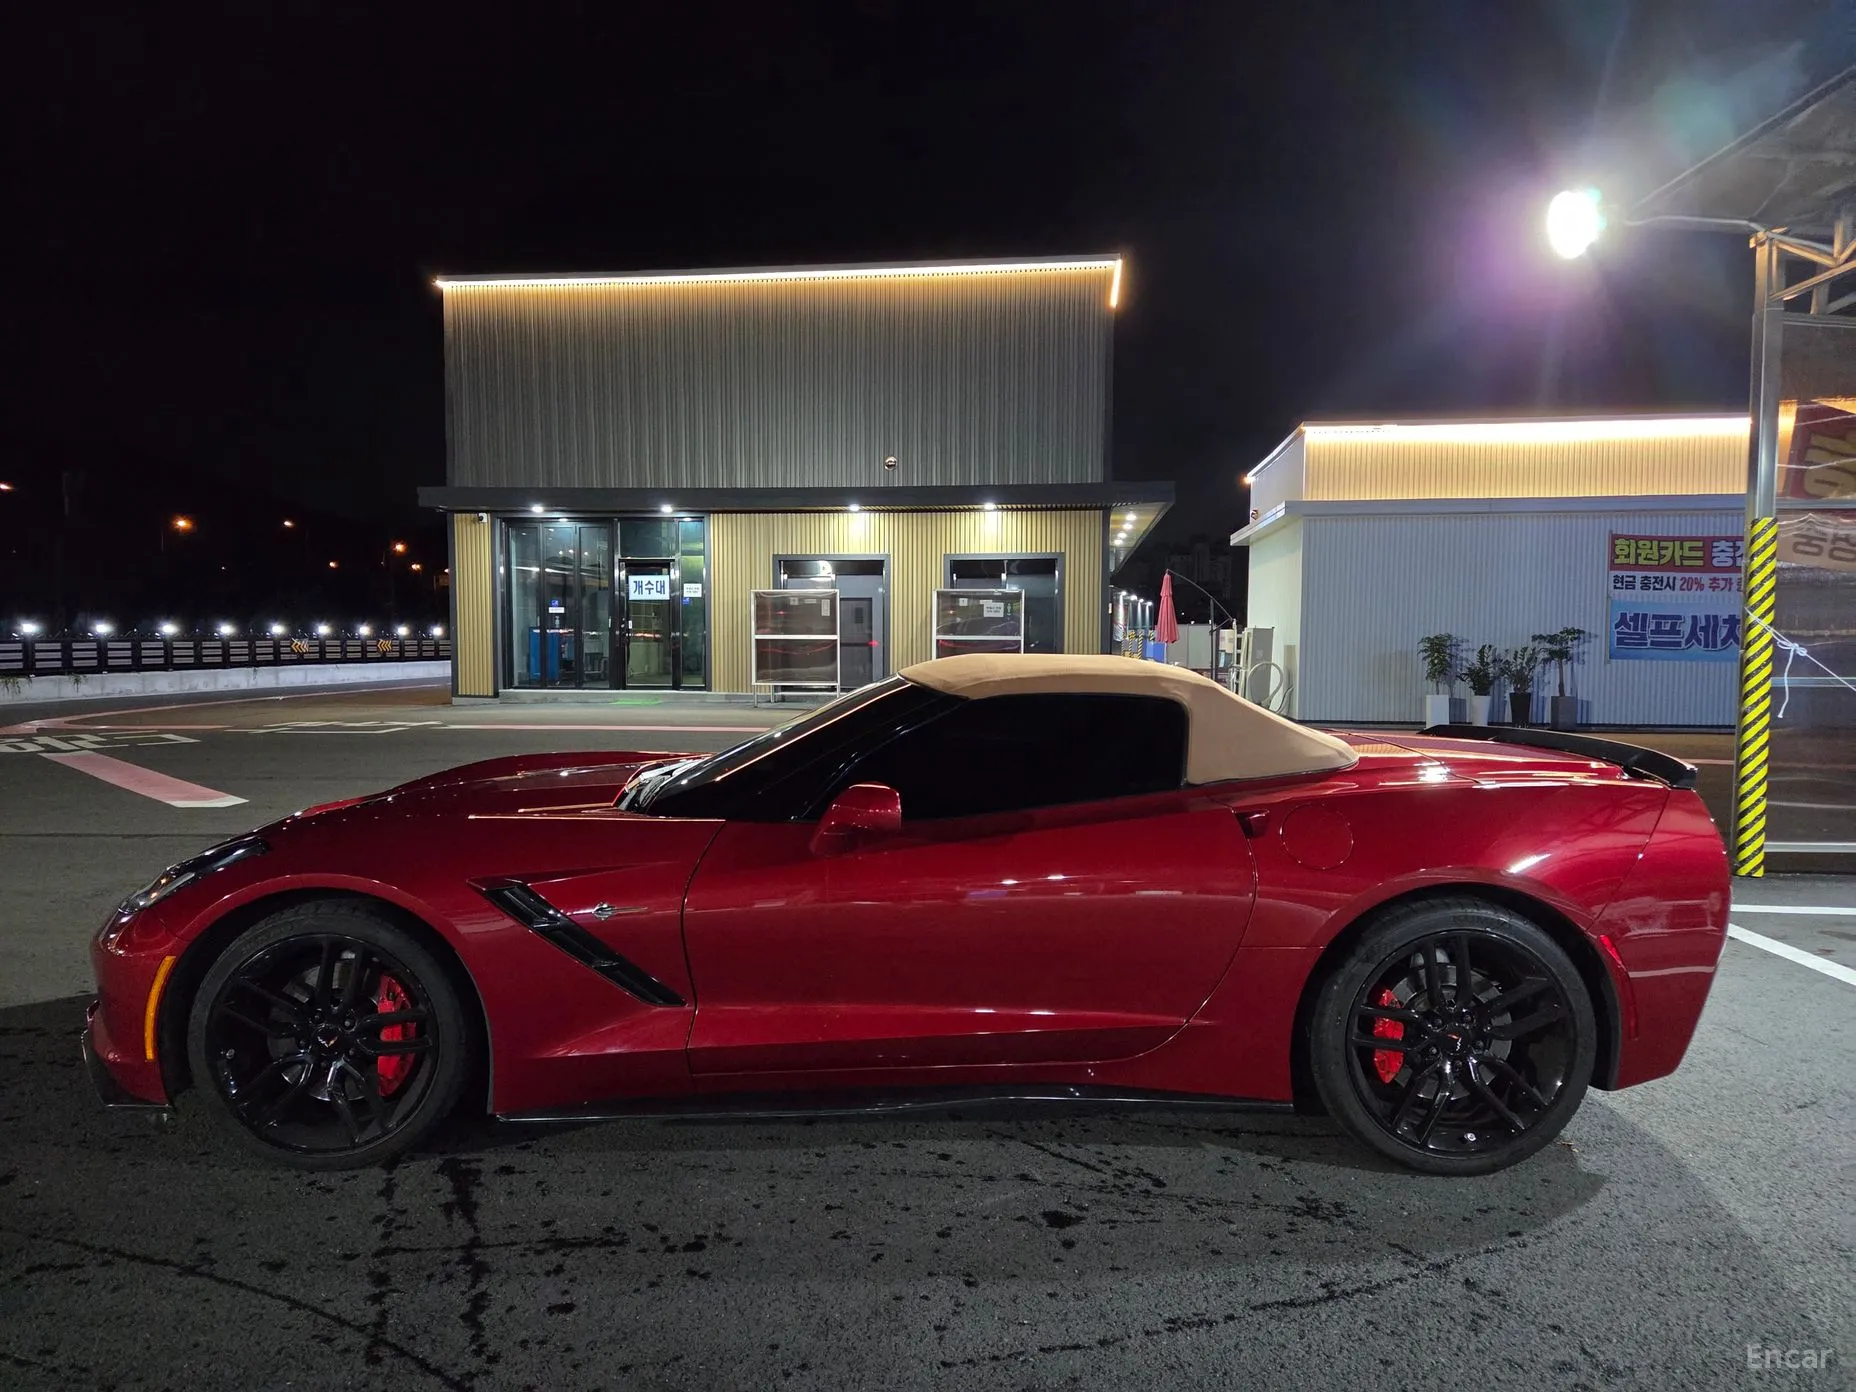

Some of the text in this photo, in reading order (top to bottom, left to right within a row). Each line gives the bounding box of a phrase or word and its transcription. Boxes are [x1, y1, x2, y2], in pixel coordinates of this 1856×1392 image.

[1614, 538, 1704, 567] 회원카드
[633, 580, 666, 595] 개수대
[1613, 575, 1636, 590] 현금
[1640, 576, 1676, 591] 충전시
[1680, 577, 1705, 591] 20%
[1708, 577, 1733, 592] 추가
